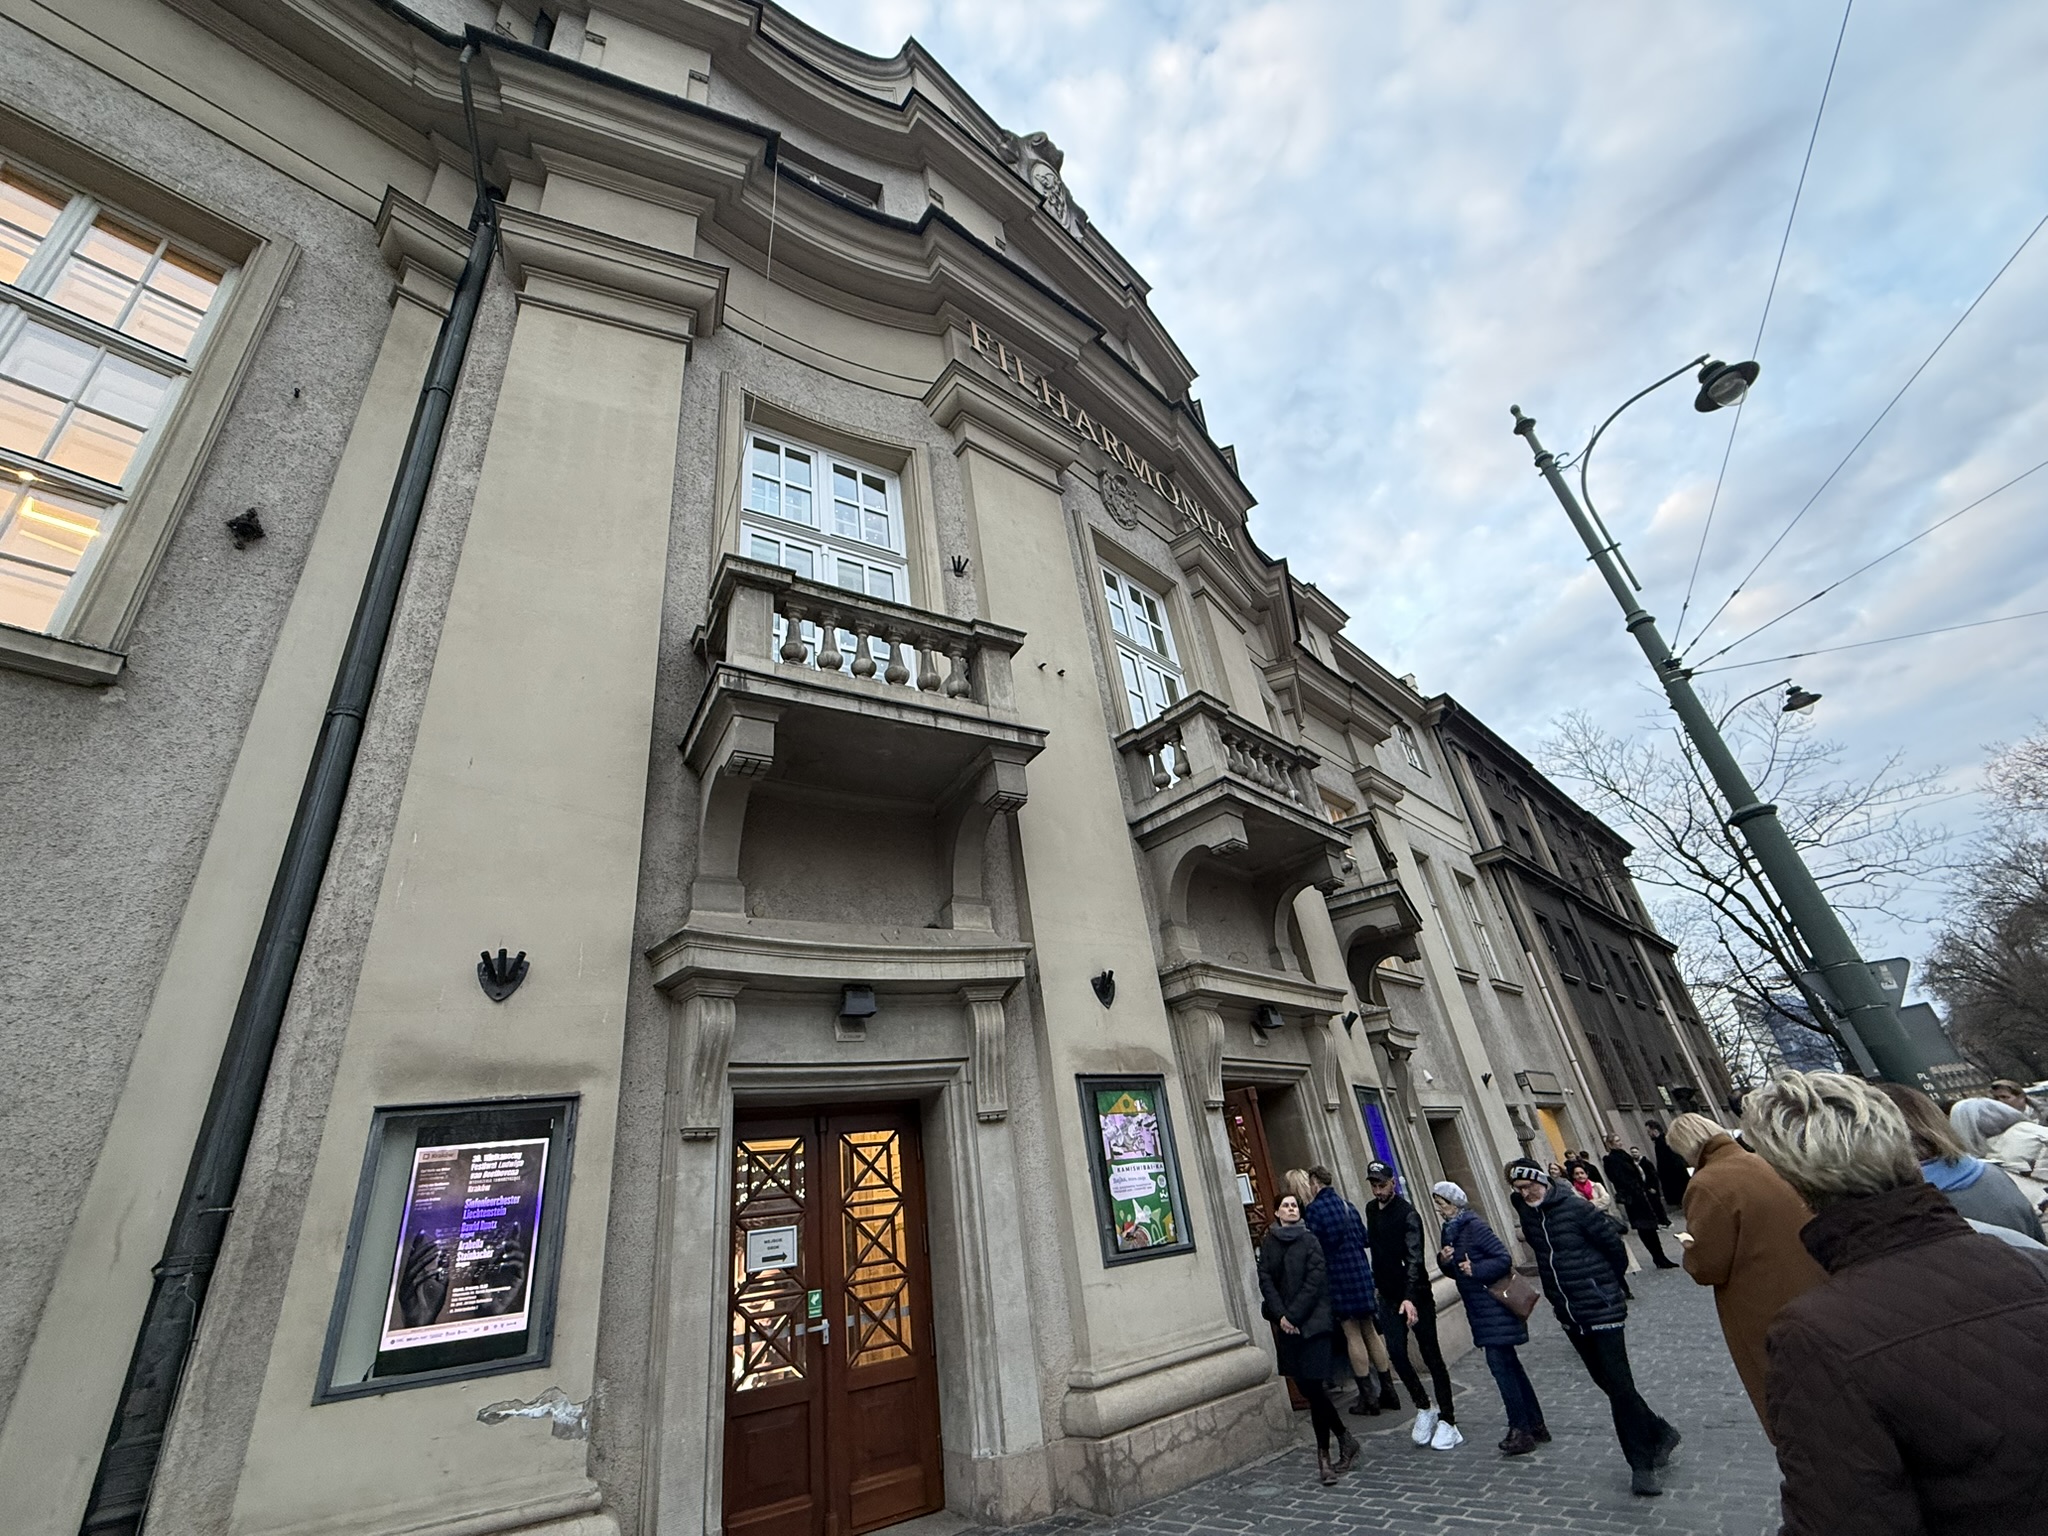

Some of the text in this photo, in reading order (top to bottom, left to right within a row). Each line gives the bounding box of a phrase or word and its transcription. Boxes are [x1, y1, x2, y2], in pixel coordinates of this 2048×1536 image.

[965, 318, 1238, 553] FILHARMONIA
[1916, 1072, 1930, 1081] PL
[462, 1206, 507, 1219] Liechtenstein
